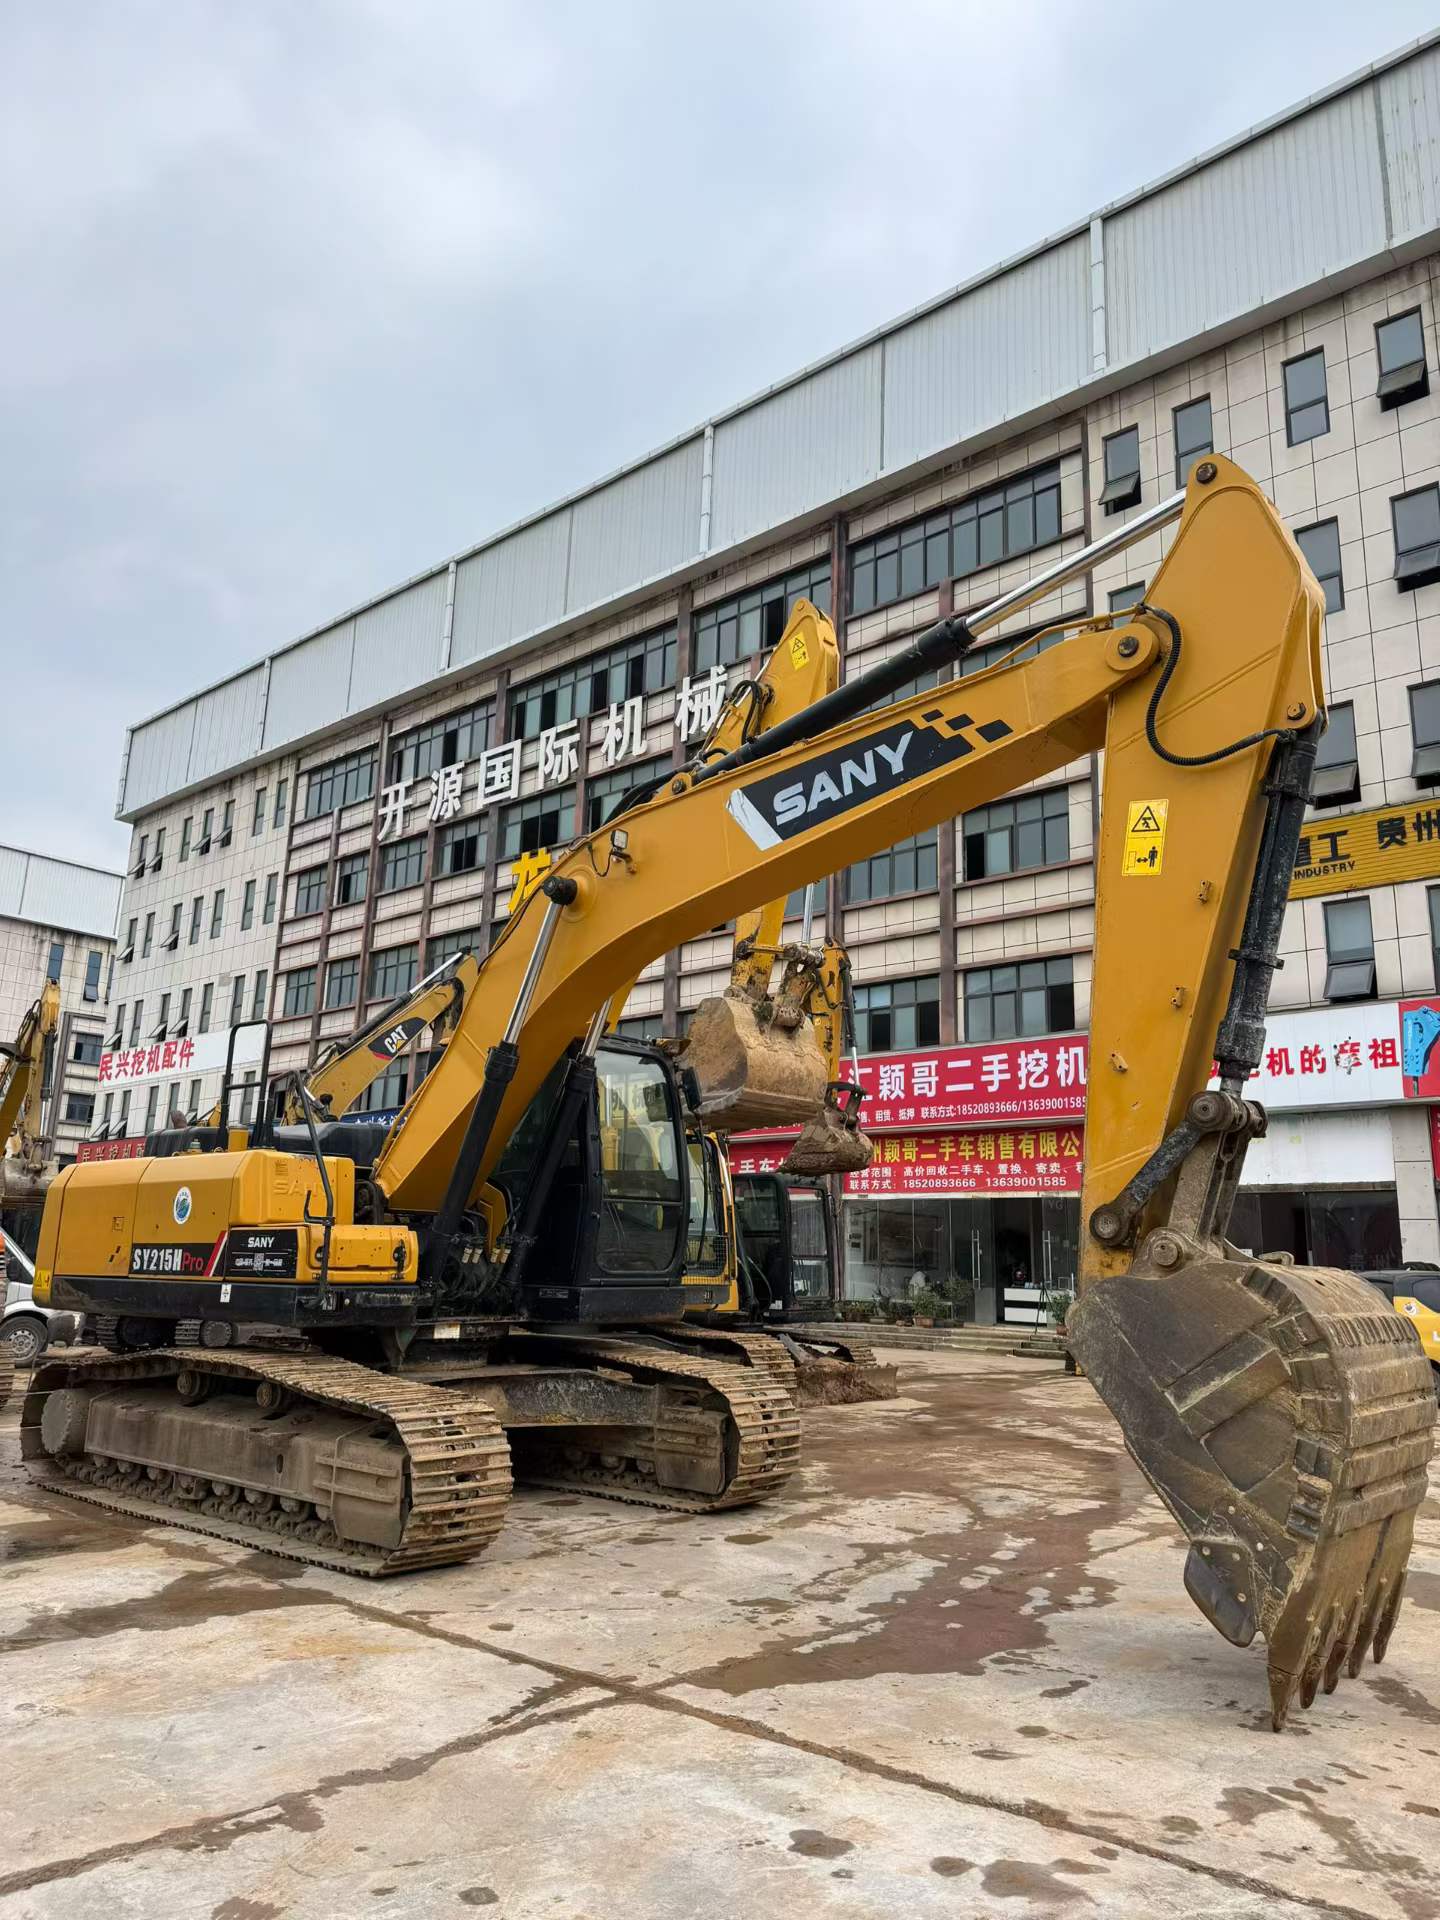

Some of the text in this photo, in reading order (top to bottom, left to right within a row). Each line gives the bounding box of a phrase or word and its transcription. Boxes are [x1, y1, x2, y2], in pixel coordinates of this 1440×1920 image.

[377, 665, 728, 841] 开源国际机械
[772, 731, 913, 827] SANY
[1294, 861, 1356, 880] INDUSTRY
[384, 1025, 408, 1053] CAT
[98, 1037, 195, 1082] 民兴挖机配件
[986, 1176, 1067, 1187] 13639001585
[247, 1236, 275, 1248] SANY
